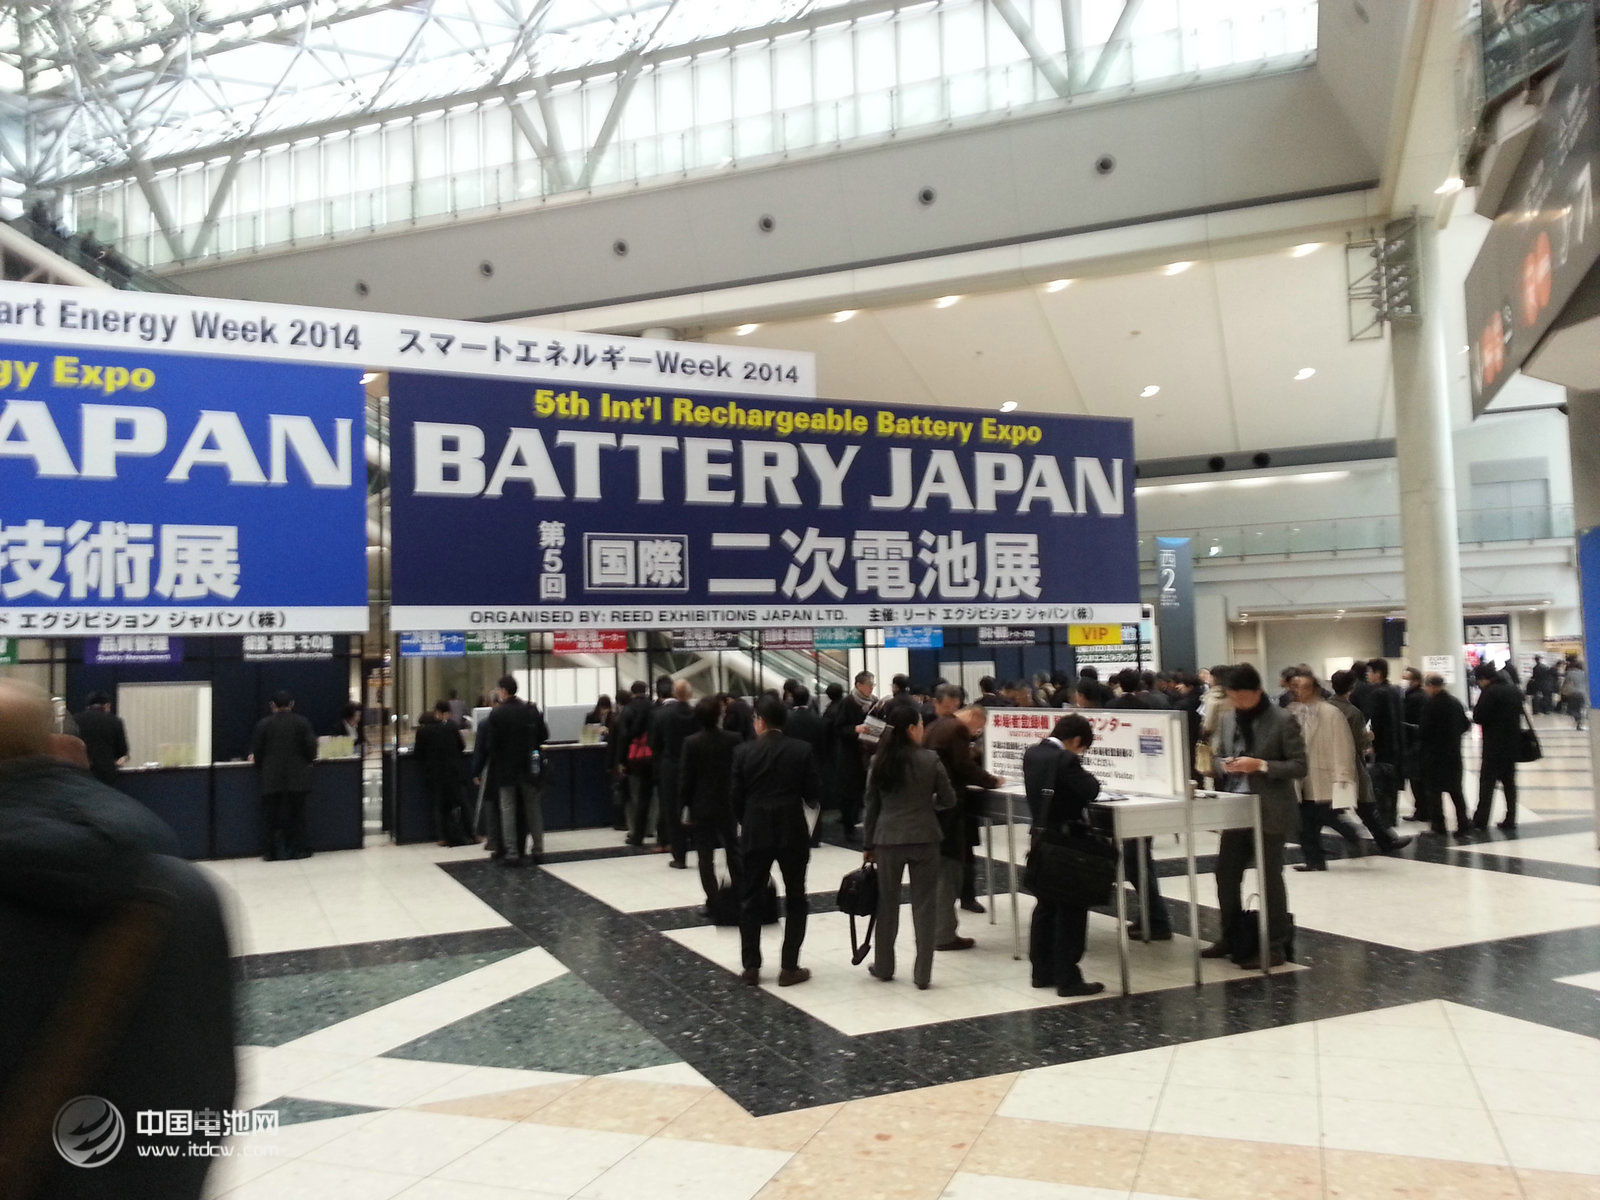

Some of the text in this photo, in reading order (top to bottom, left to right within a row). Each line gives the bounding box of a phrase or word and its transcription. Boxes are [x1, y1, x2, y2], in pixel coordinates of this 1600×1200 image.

[0, 298, 361, 350] art Energy Week 2014
[54, 355, 156, 396] Expo
[398, 328, 801, 384] スマートエネルギーWeek 2014
[0, 399, 353, 488] APAN
[534, 387, 1044, 447] 5th Int'l Rechargeable Battery Expo
[412, 421, 1125, 518] BATTERY JAPAN
[0, 518, 241, 601] 技術展
[538, 520, 567, 602] 第5回
[589, 526, 1042, 599] 国際 二次電池展
[1161, 568, 1176, 592] 2
[470, 609, 848, 624] ORGANISED BY: REED EXHIBITIONS JAPAN LTD.
[1081, 626, 1109, 642] VIP
